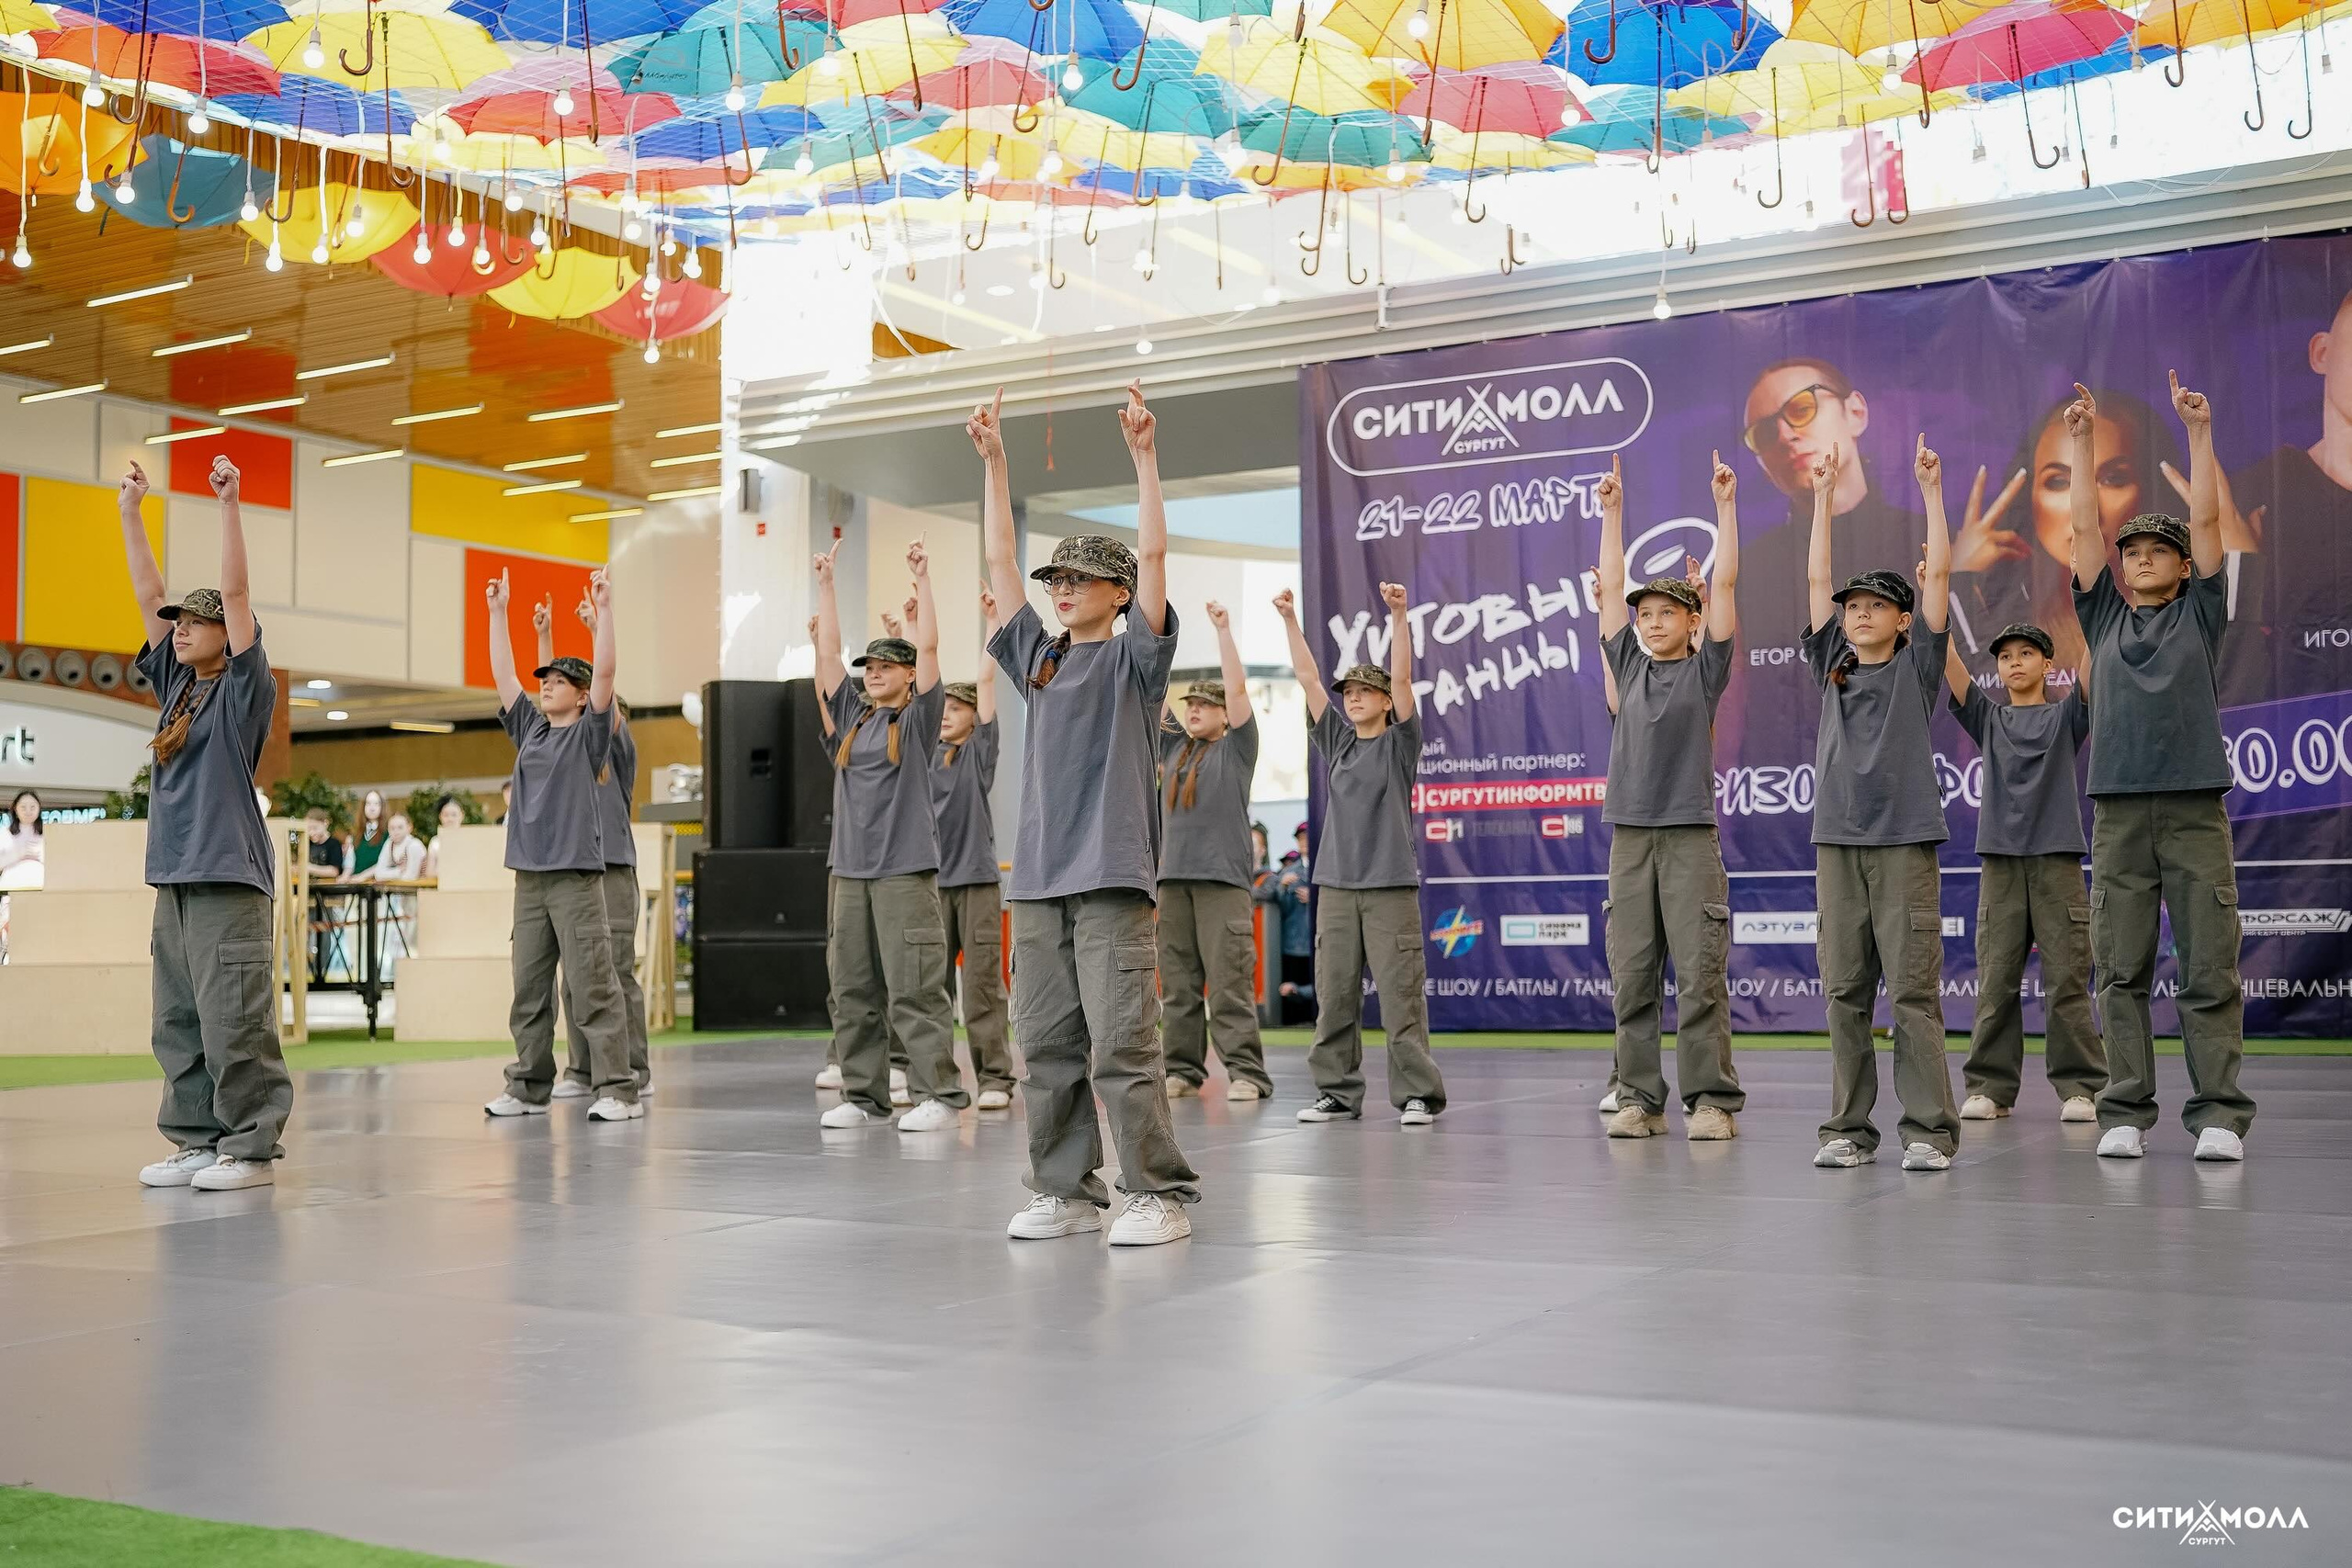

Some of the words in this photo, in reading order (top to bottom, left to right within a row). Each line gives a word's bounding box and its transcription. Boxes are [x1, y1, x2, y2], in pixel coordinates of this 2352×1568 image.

[1353, 397, 1464, 440] СИТИ
[1497, 378, 1624, 423] МОЛЛ
[1453, 436, 1507, 454] СУРГУТ
[1355, 490, 1483, 541] 21-22
[2304, 628, 2352, 649] ИГО
[1749, 647, 1795, 666] ЕГОР
[1502, 751, 1587, 773] партнер:
[1426, 783, 1606, 807] СУРГУТИНФОРМТВ
[1437, 978, 1480, 997] ШОУ
[1495, 977, 1558, 997] БАТТЛЫ
